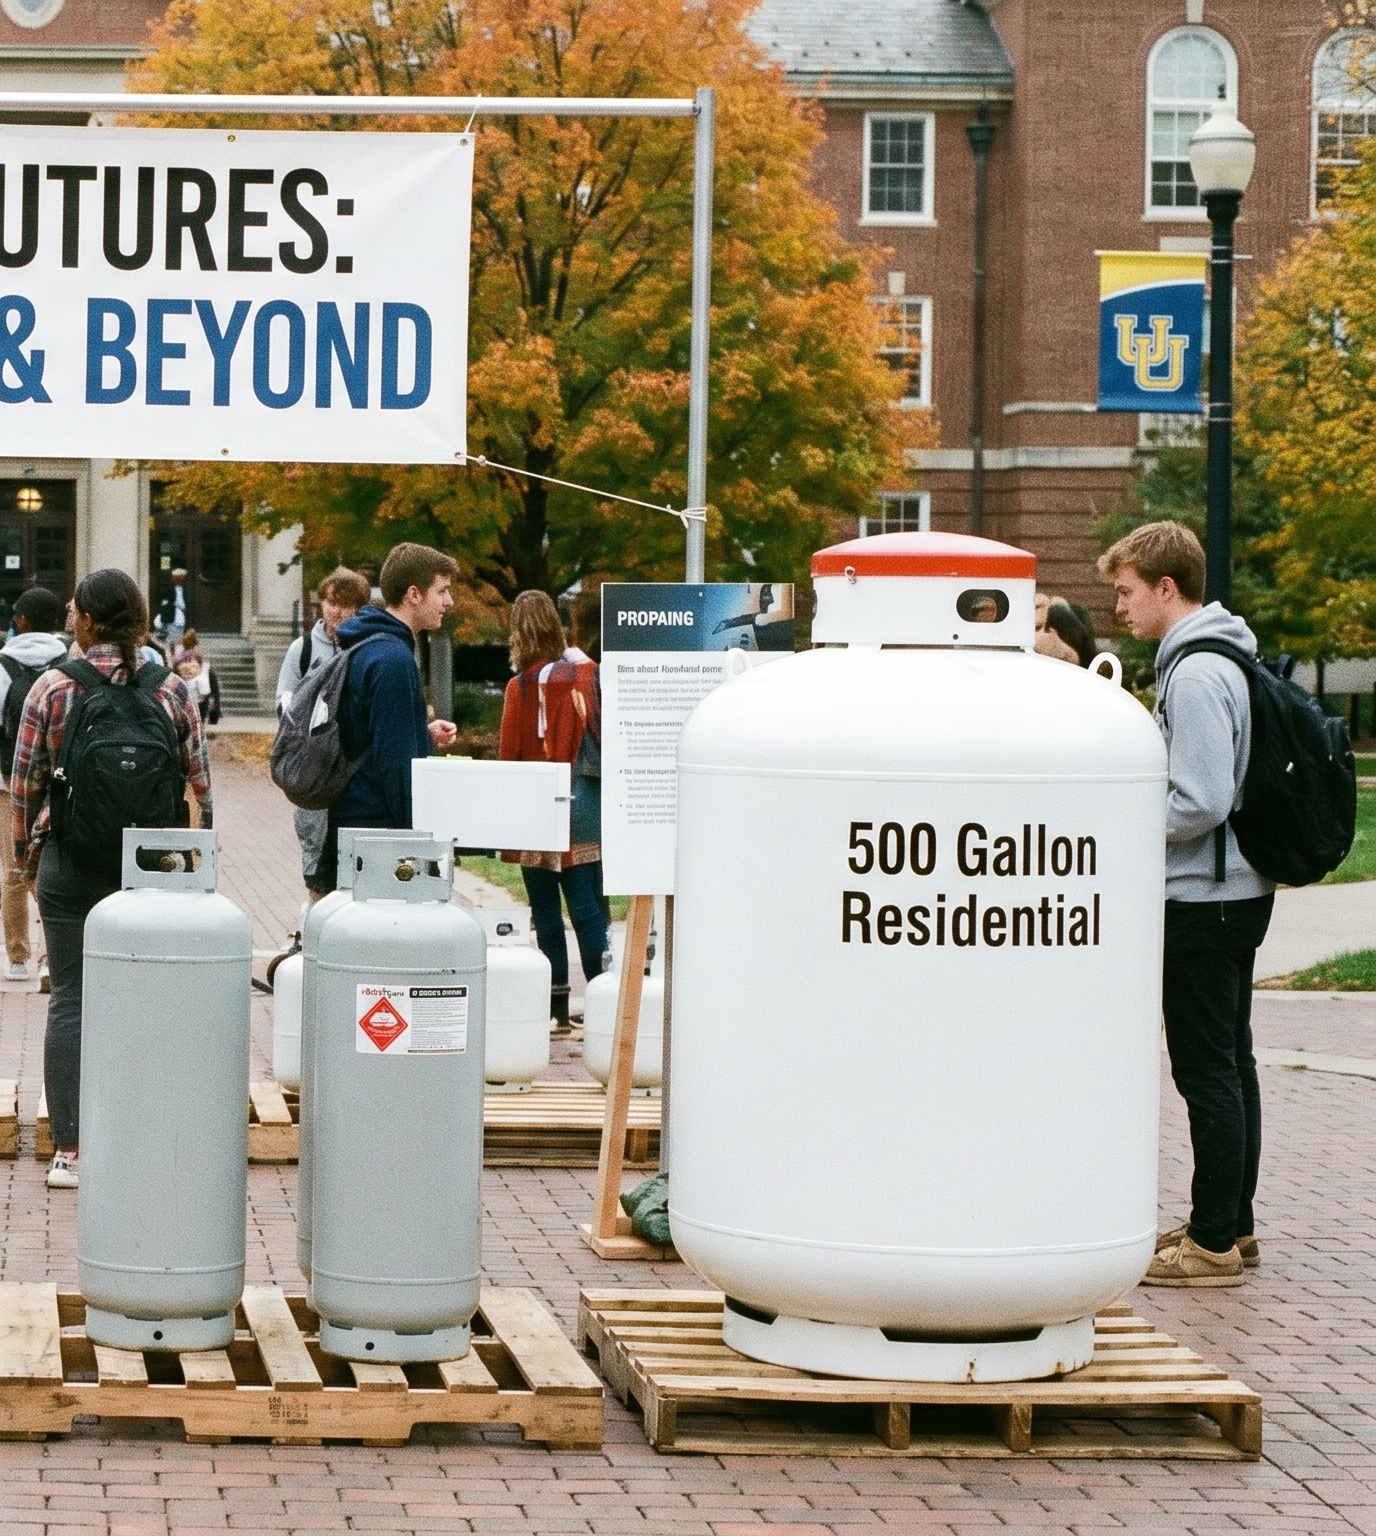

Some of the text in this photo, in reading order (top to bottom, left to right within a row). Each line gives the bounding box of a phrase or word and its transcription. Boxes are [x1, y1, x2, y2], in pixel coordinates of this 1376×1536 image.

[84, 296, 434, 411] BEYOND
[617, 610, 694, 627] PROPAING
[847, 821, 1097, 877] 500 Gallon
[841, 890, 1101, 947] Residential
